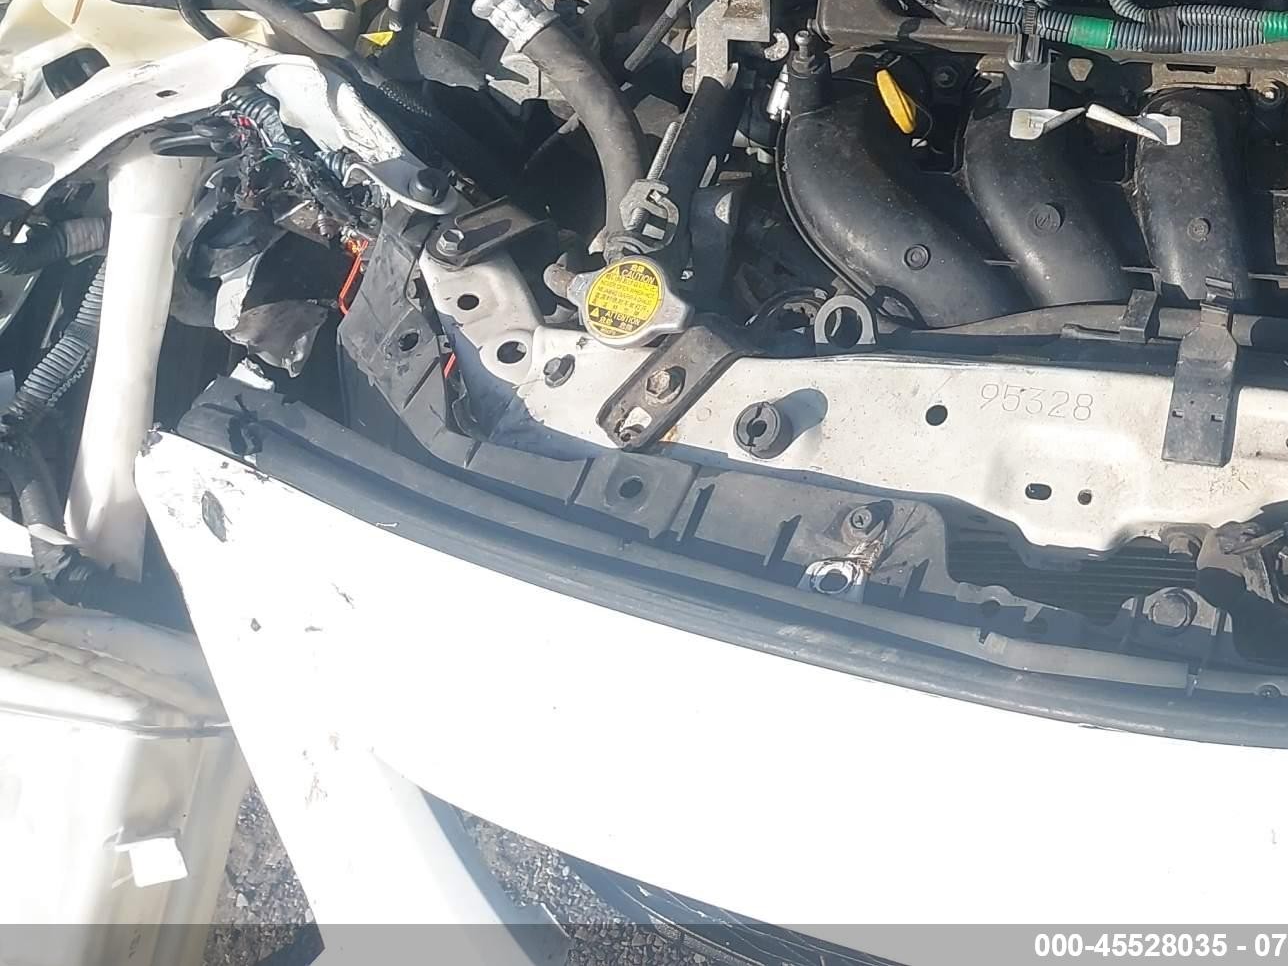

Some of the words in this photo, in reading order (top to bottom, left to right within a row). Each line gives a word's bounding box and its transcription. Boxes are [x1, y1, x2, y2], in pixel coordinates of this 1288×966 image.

[621, 269, 656, 284] CAUTION
[604, 310, 641, 326] ATTENTION
[980, 383, 1094, 422] 95328
